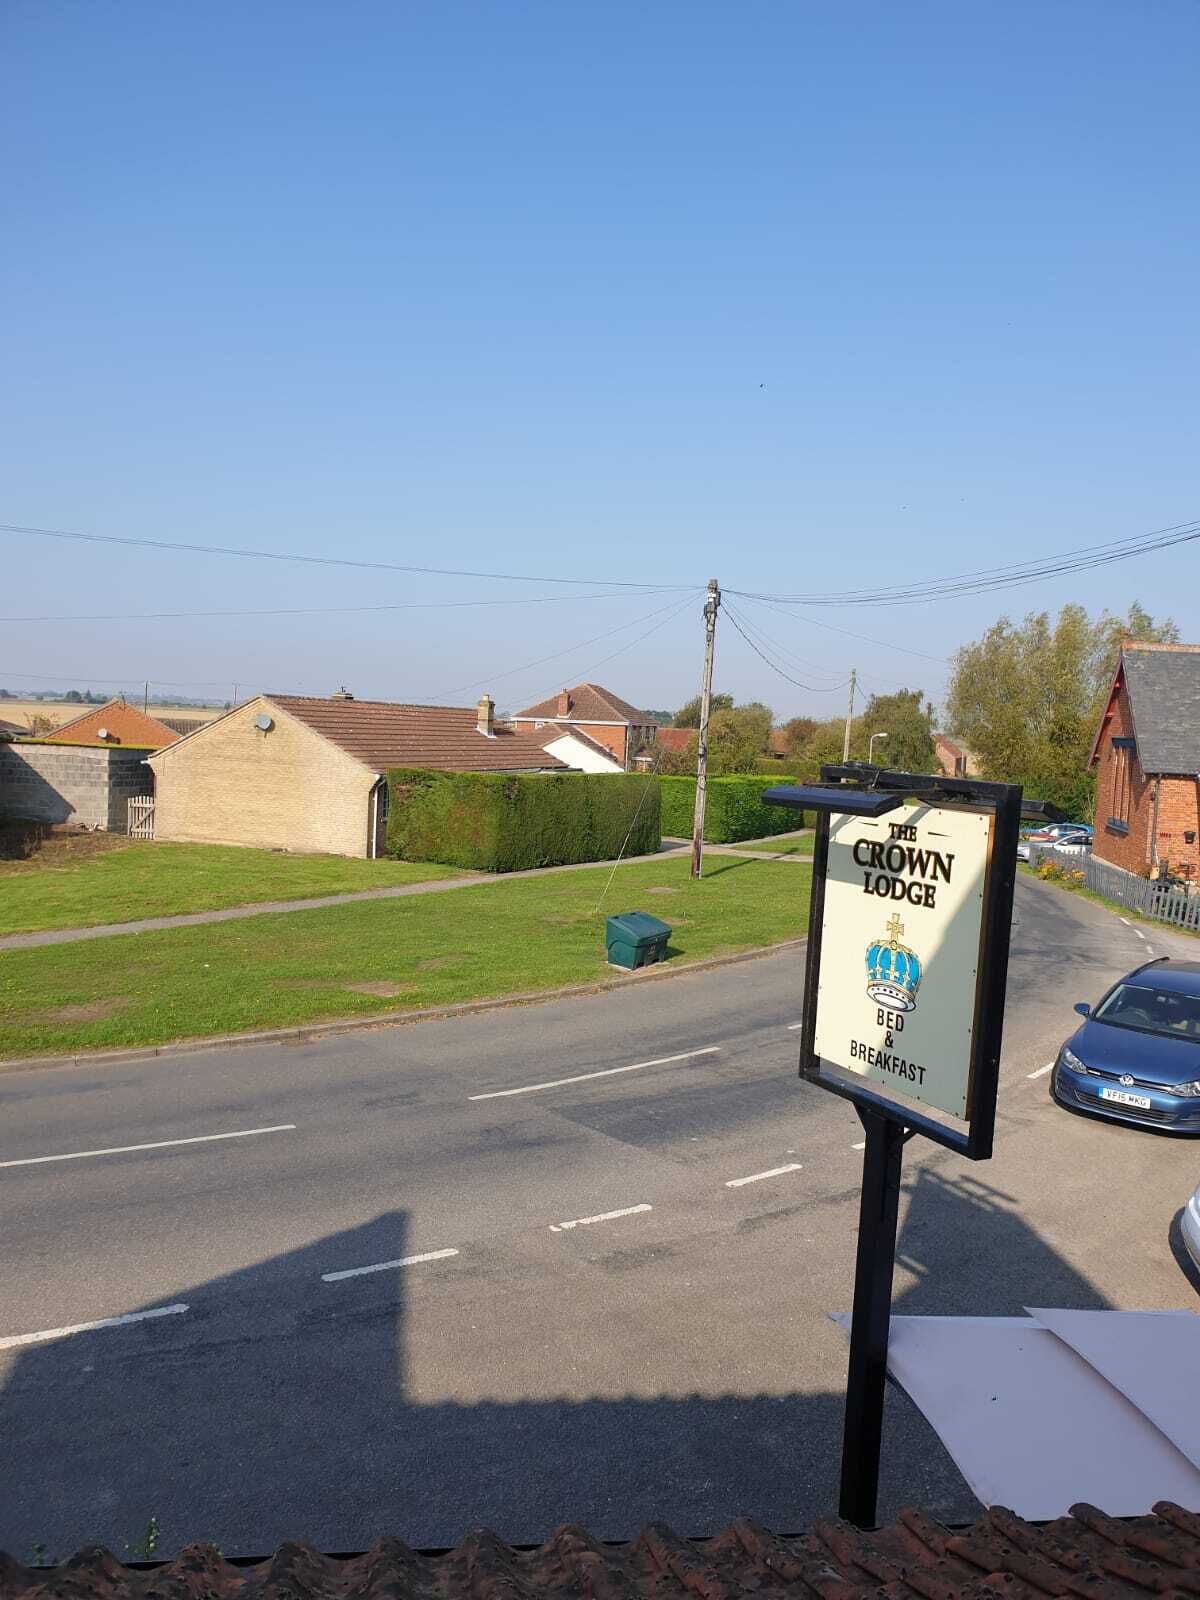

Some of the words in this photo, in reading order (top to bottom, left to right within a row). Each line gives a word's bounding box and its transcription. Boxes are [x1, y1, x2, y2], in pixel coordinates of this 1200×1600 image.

[888, 822, 918, 842] THE
[852, 838, 955, 883] CROWN
[863, 871, 936, 909] LODGE
[876, 1008, 905, 1032] BED
[884, 1031, 894, 1049] &
[850, 1040, 927, 1085] BREAKFAST
